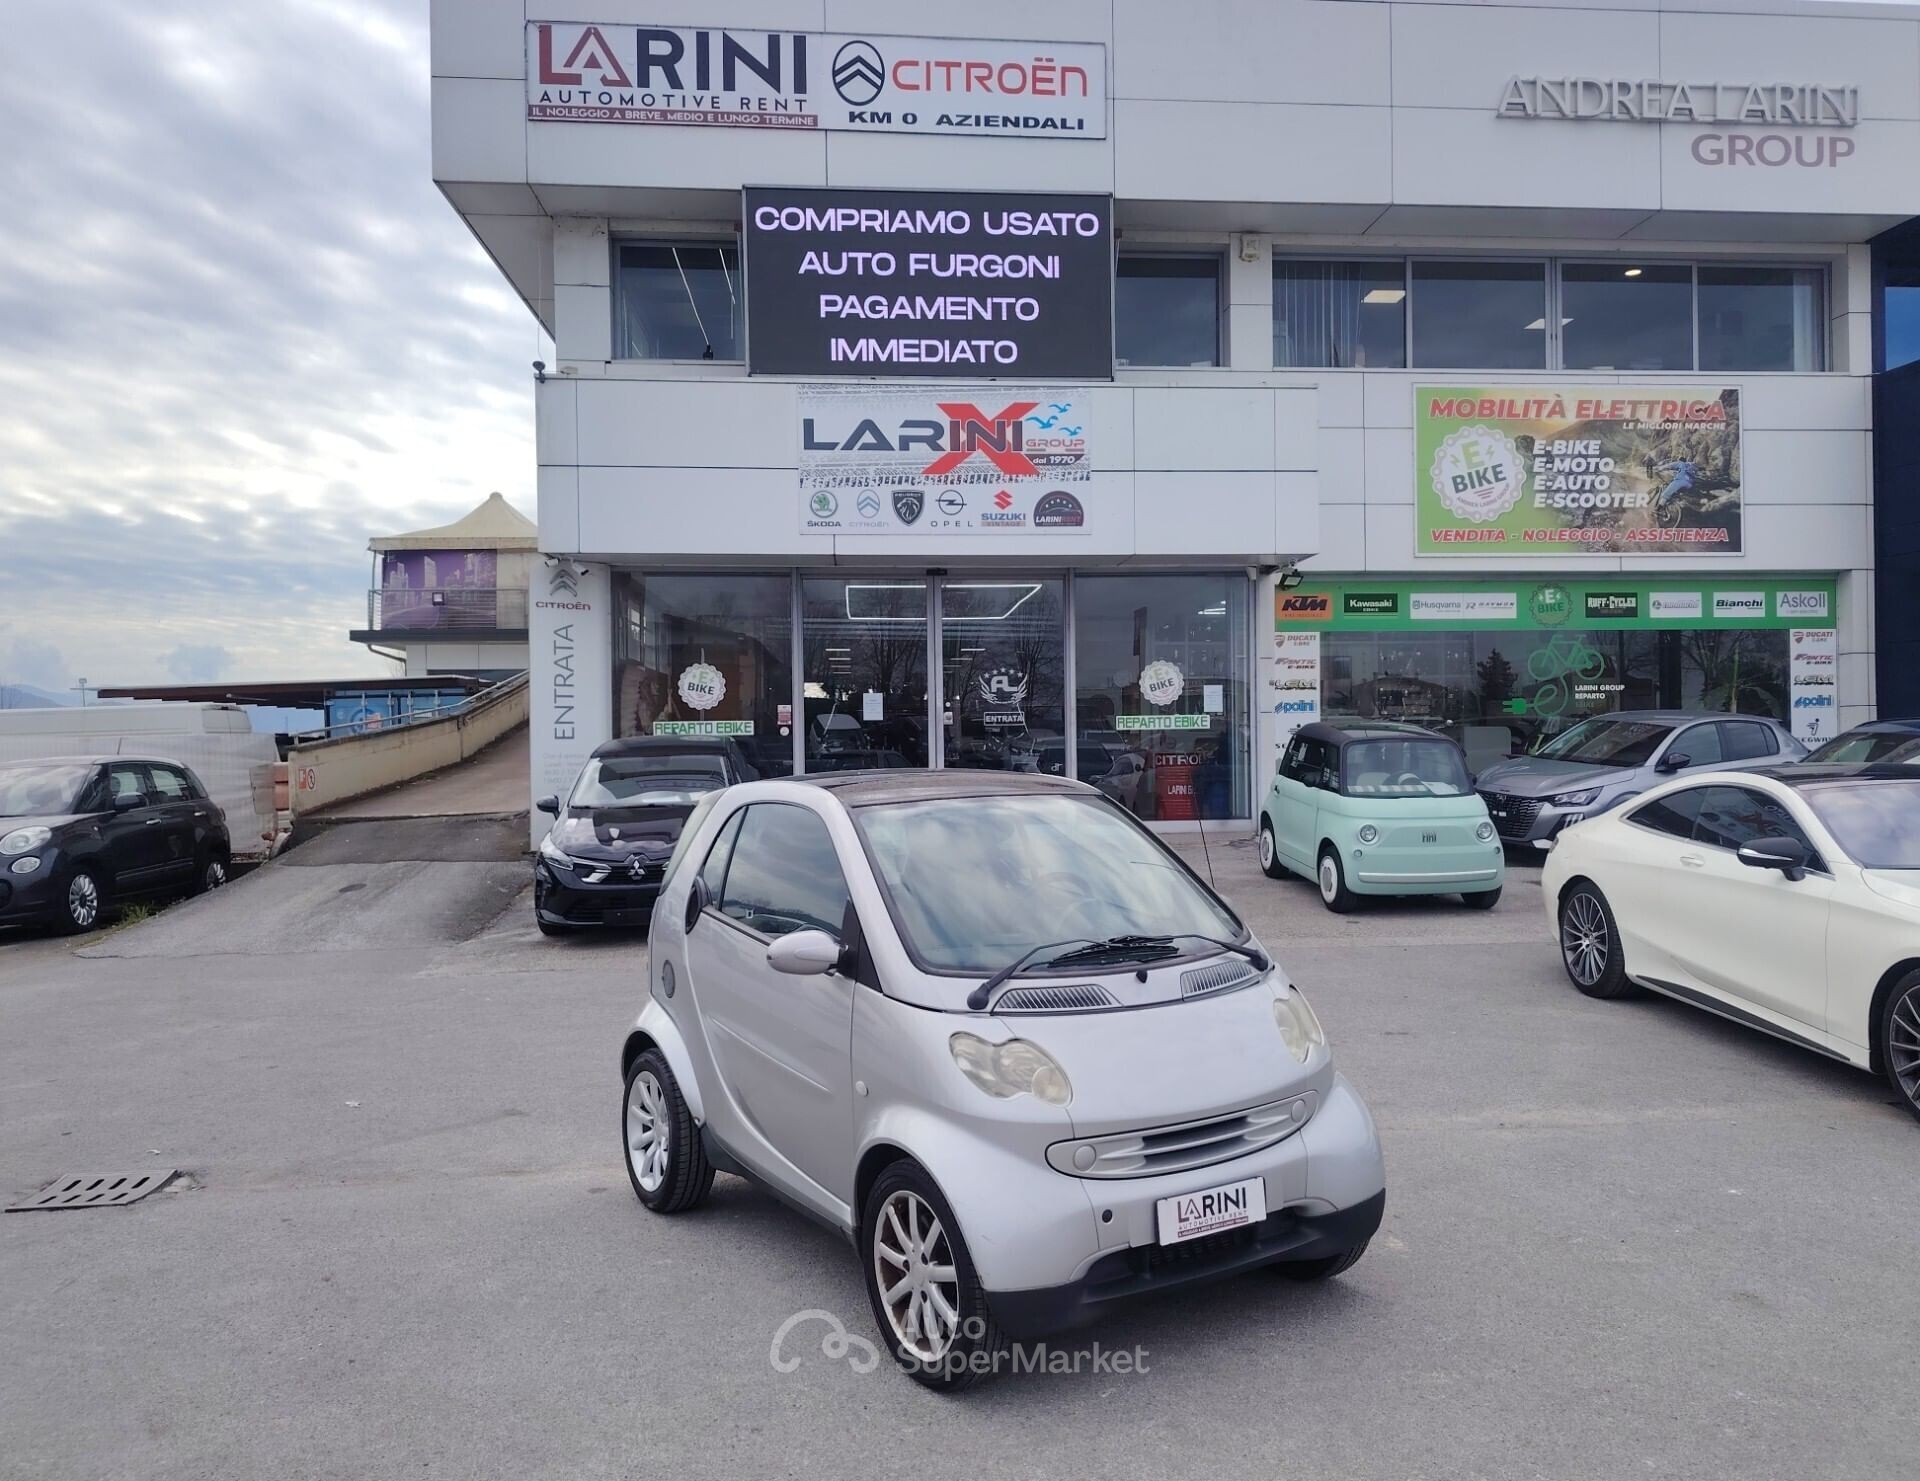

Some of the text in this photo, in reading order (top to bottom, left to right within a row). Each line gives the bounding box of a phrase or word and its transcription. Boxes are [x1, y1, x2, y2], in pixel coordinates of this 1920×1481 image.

[538, 24, 807, 95] LARINI
[892, 56, 1088, 97] CITROËN
[539, 91, 808, 113] AUTOMOTIVE RENT
[1498, 74, 1697, 121] ANDREA
[532, 108, 542, 116] IL
[547, 107, 609, 118] NOLEGGIO
[613, 110, 622, 119] A
[667, 112, 704, 122] MEDIO
[708, 113, 715, 122] E
[718, 114, 760, 123] LUNGO
[763, 115, 815, 126] TERMINE
[848, 111, 892, 125] KM
[936, 114, 1085, 131] AZIENDALI
[1691, 133, 1855, 168] GROUP
[754, 206, 1100, 238] COMPRIAMO USATO
[798, 251, 1061, 279] AUTO FURGONI
[820, 294, 1040, 322] PAGAMENTO
[831, 337, 1018, 364] IMMEDIATO
[1429, 393, 1726, 420] MOBILITÀ ELETTRICA
[1622, 422, 1726, 430] LE MIGLIORI MARCHE
[803, 418, 1023, 452] LARINI
[1026, 438, 1085, 448] GROUP
[1461, 440, 1485, 470] E
[1532, 439, 1601, 455] E-BIKE
[1049, 456, 1075, 464] 1970
[1532, 457, 1615, 473] E-MOTO
[1451, 463, 1507, 494] BIKE
[1533, 475, 1610, 491] E-AUTO
[1533, 493, 1650, 509] E-SCOOTER
[930, 520, 973, 528] OPEL
[981, 512, 1026, 521] SUZUKI
[1431, 529, 1506, 543] VENDITA
[1522, 529, 1611, 542] NOLEGGIO
[1626, 528, 1729, 543] ASSISTENZA
[1282, 595, 1328, 611] KTM
[1350, 599, 1392, 607] Kawasaki
[1544, 589, 1556, 604] E
[1716, 599, 1763, 607] Bianchi
[1780, 593, 1826, 608] Askoll
[536, 601, 591, 611] CITROËN
[1421, 600, 1461, 610] Husqvarna
[1537, 602, 1565, 614] BIKE
[554, 623, 575, 740] ENTRATA
[699, 671, 709, 684] E
[1149, 677, 1175, 693] BIKE
[687, 682, 716, 696] BIKE
[1284, 699, 1314, 713] polini
[1802, 695, 1831, 708] polini
[985, 715, 1022, 723] ENTRATA
[1117, 716, 1208, 729] REPARTO EBIKE
[655, 721, 752, 735] REPARTO EBIKE
[1177, 1187, 1247, 1223] LARINI
